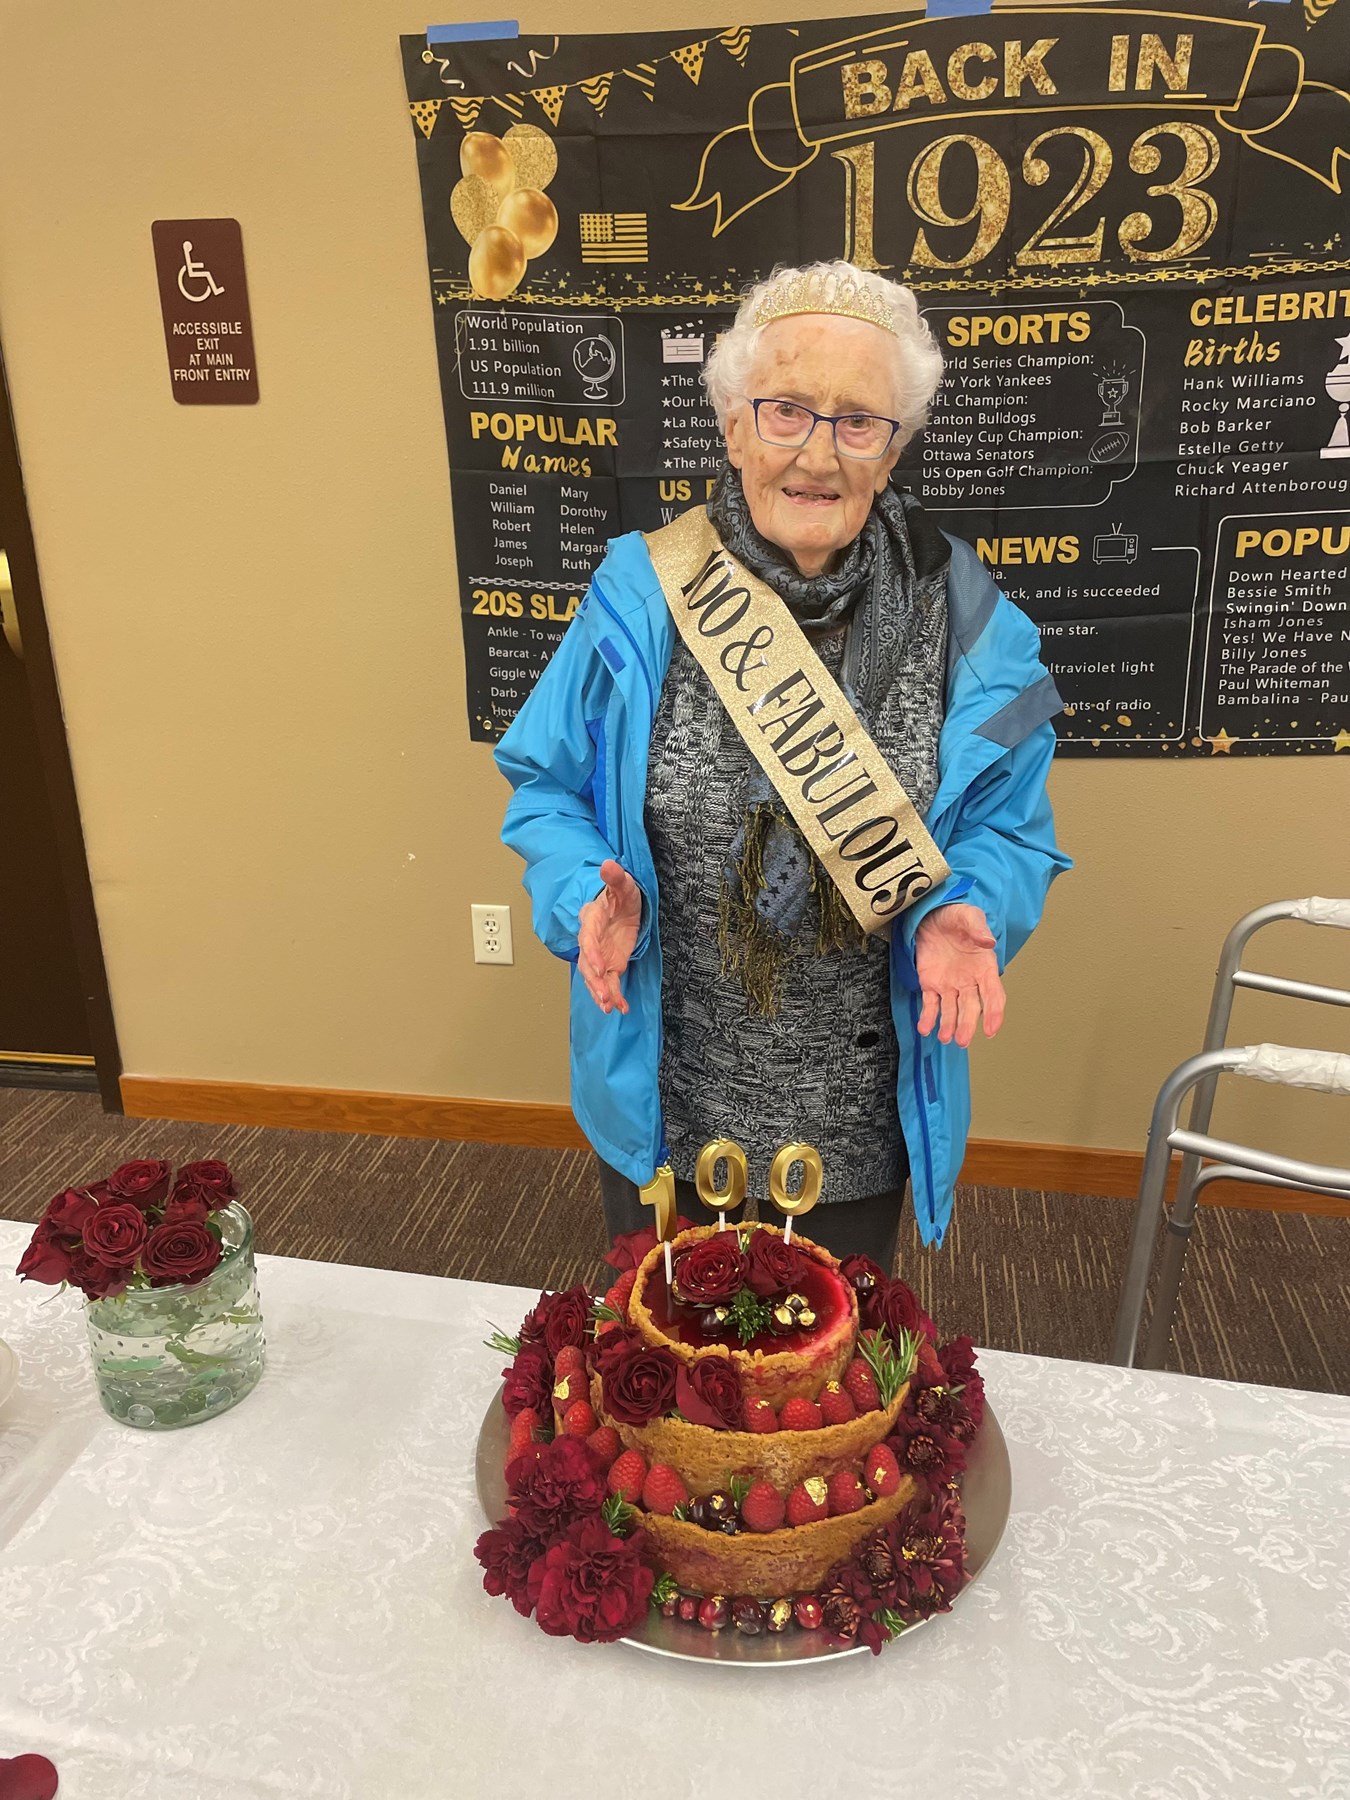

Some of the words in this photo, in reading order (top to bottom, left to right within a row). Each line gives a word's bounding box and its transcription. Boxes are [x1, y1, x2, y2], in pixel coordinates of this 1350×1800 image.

[840, 36, 1061, 120] BACK
[1106, 33, 1194, 93] IN
[830, 121, 1221, 270] 1923
[173, 322, 242, 335] ACCESSIBLE
[466, 316, 508, 330] World
[512, 318, 583, 334] Population
[947, 311, 1091, 347] SPORTS
[196, 338, 220, 350] EXIT
[469, 338, 498, 351] 1.91
[503, 339, 540, 354] billion
[1184, 330, 1280, 368] Births
[189, 354, 201, 366] AT
[206, 354, 233, 366] MAIN
[943, 357, 967, 369] orld
[972, 356, 1012, 369] Series
[1017, 352, 1094, 369] Champion:
[174, 369, 209, 381] FRONT
[215, 369, 251, 381] ENTRY
[470, 360, 488, 372] US
[494, 360, 561, 377] Population
[670, 374, 694, 386] The
[938, 376, 955, 388] ew
[960, 375, 991, 388] York
[996, 373, 1052, 387] Yankees
[1183, 376, 1224, 390] Hank
[1231, 373, 1304, 388] Williams
[472, 381, 509, 395] 111.9
[514, 383, 555, 398] million
[671, 396, 696, 408] Our
[955, 393, 1028, 409] Champion:
[1182, 398, 1229, 414] Rocky
[1237, 395, 1316, 410] Marciano
[672, 417, 686, 428] La
[978, 411, 1036, 427] Bulldogs
[1180, 420, 1210, 434] Bob
[1217, 418, 1272, 432] Barker
[470, 411, 619, 447] POPULAR
[673, 436, 712, 451] Safety
[924, 431, 973, 447] Stanley
[978, 430, 1003, 445] Cup
[1008, 428, 1083, 443] Champion:
[923, 449, 971, 461] Ottawa
[976, 449, 1034, 461] Senators
[1178, 441, 1231, 455] Estelle
[1238, 440, 1284, 454] Getty
[501, 445, 592, 478] Names
[673, 457, 696, 469] The
[1176, 461, 1224, 475] Chuck
[1231, 461, 1289, 475] Yeager
[923, 467, 940, 479] US
[945, 467, 982, 481] Open
[986, 465, 1014, 478] Golf
[1018, 463, 1093, 478] Champion:
[489, 483, 527, 496] Daniel
[561, 486, 589, 502] Mary
[659, 480, 692, 501] US
[922, 484, 965, 499] Bobby
[969, 484, 1005, 496] Jones
[1175, 482, 1235, 496] Richard
[1242, 479, 1348, 494] Attenboroug
[490, 501, 535, 514] William
[560, 504, 607, 521] Dorothy
[492, 519, 531, 532] Robert
[560, 522, 595, 535] Helen
[494, 537, 528, 550] James
[976, 535, 1080, 565] NEWS
[495, 554, 533, 569] Joseph
[562, 558, 591, 570] Ruth
[1229, 571, 1273, 583] Down
[1281, 567, 1347, 580] Hearted
[680, 548, 752, 638] 100
[1004, 587, 1030, 600] ack,
[1035, 586, 1061, 598] and
[1067, 586, 1078, 598] is
[1083, 584, 1160, 597] succeeded
[1227, 585, 1277, 598] Bessie
[1285, 584, 1331, 597] Smith
[472, 590, 524, 617] 20S
[1226, 601, 1295, 615] Swingin'
[1302, 601, 1347, 612] Down
[1068, 625, 1098, 635] star.
[1224, 617, 1270, 629] Isham
[1277, 616, 1323, 627] Jones
[487, 626, 519, 638] Ankle
[529, 629, 544, 640] To
[1223, 633, 1254, 644] Yes!
[1262, 632, 1286, 643] We
[1293, 631, 1333, 642] Have
[489, 646, 529, 659] Bearcat
[540, 650, 549, 661] A
[719, 624, 775, 692] &
[1221, 648, 1256, 662] Billy
[1261, 647, 1307, 659] Jones
[489, 667, 526, 681] Giggle
[1047, 661, 1115, 674] ltraviolet
[1121, 661, 1154, 675] light
[1220, 663, 1245, 675] The
[1250, 662, 1297, 674] Parade
[1301, 661, 1317, 673] of
[1321, 661, 1343, 673] the
[1219, 678, 1249, 690] Paul
[1255, 677, 1329, 689] Whiteman
[491, 687, 518, 698] Darb
[1218, 693, 1300, 705] Bambalina
[1063, 700, 1090, 711] ents
[1095, 699, 1110, 711] of
[1116, 699, 1151, 710] radio
[746, 668, 933, 916] FABULOUS
